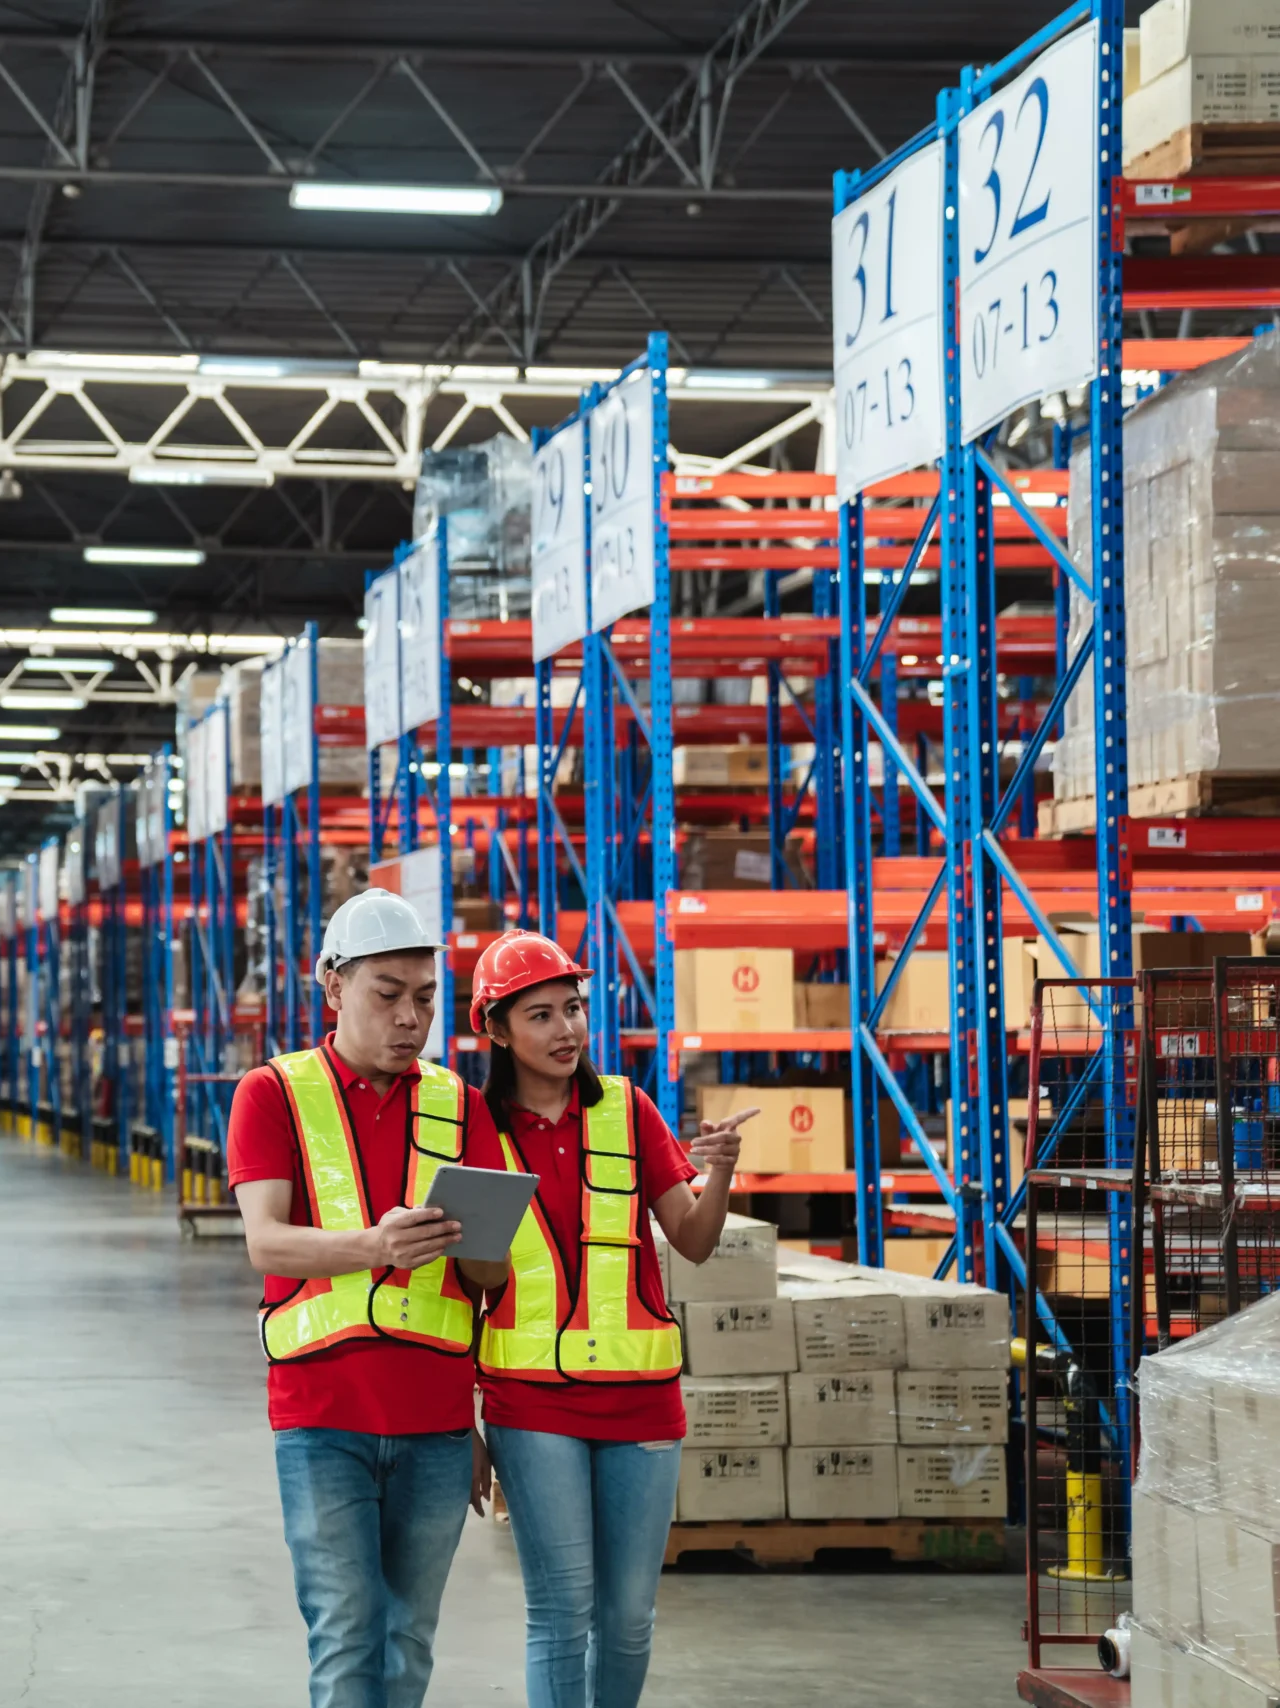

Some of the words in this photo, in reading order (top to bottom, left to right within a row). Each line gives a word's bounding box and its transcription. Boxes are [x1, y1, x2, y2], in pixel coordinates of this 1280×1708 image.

[974, 77, 1052, 264] 32
[845, 186, 897, 348] 31
[972, 269, 1060, 380] 07-13
[844, 357, 916, 450] 07-13
